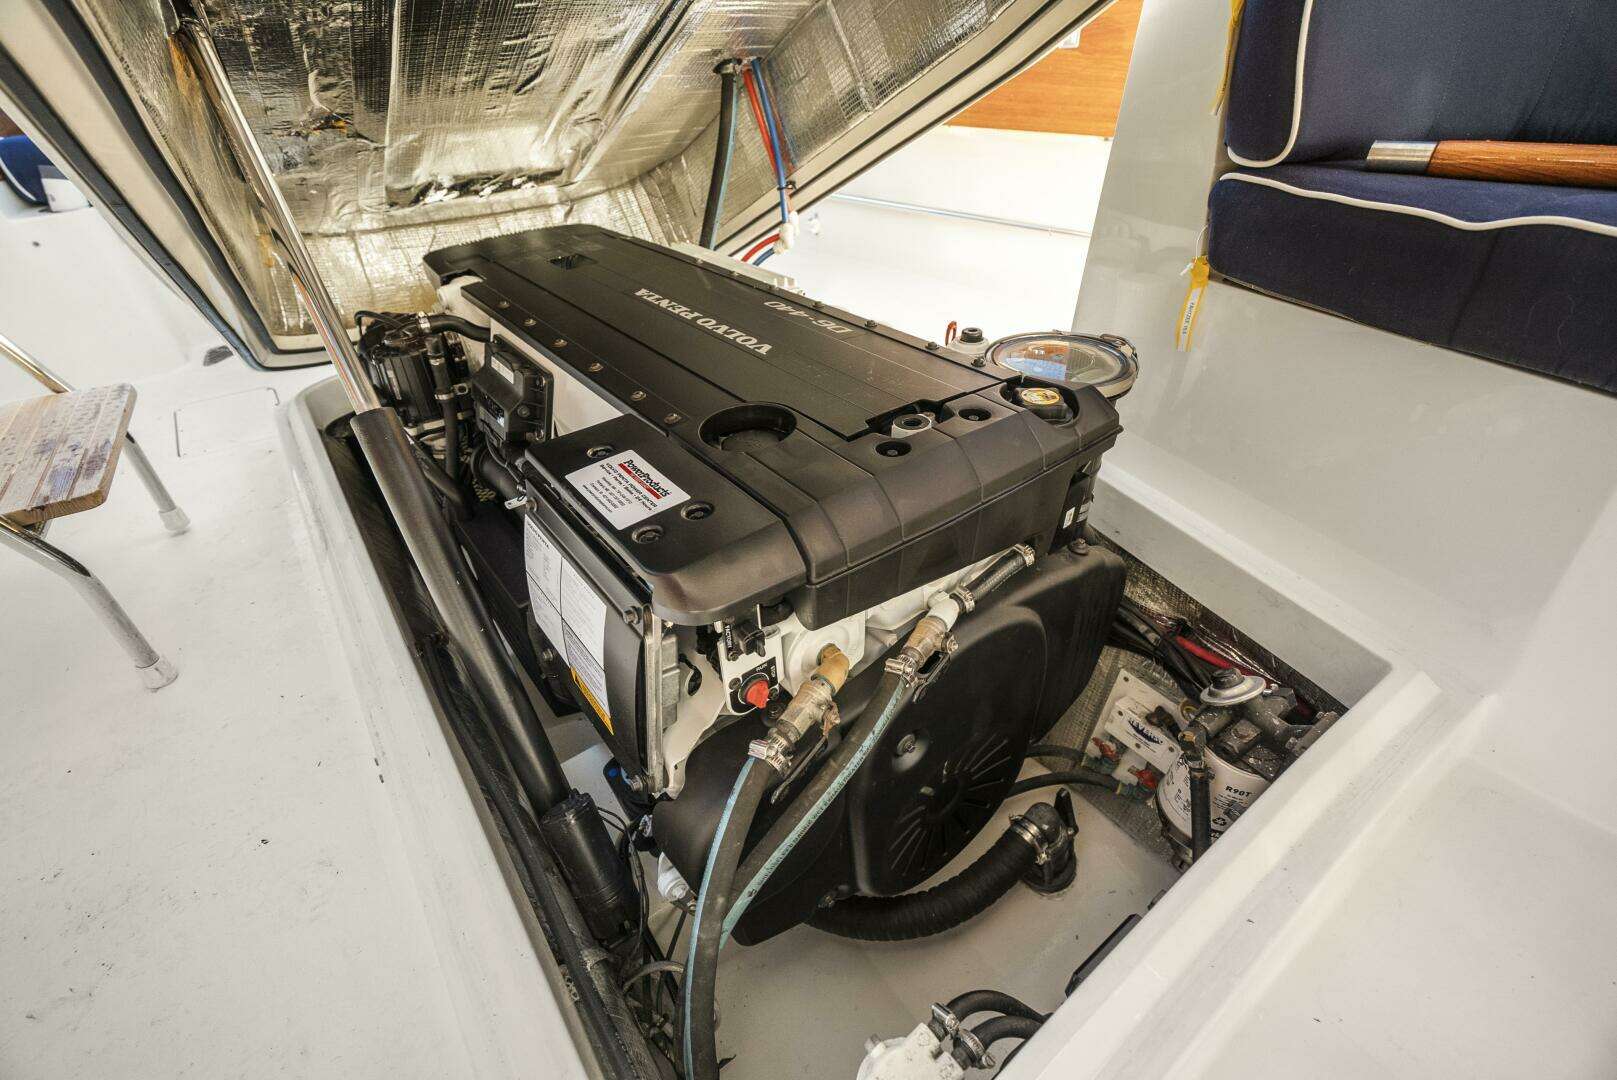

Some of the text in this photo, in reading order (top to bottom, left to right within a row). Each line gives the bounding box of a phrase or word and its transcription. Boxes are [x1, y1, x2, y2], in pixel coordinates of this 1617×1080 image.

[634, 288, 772, 355] VOLVO PENTA
[623, 459, 671, 497] PowerProducts
[1225, 785, 1252, 798] R90T
